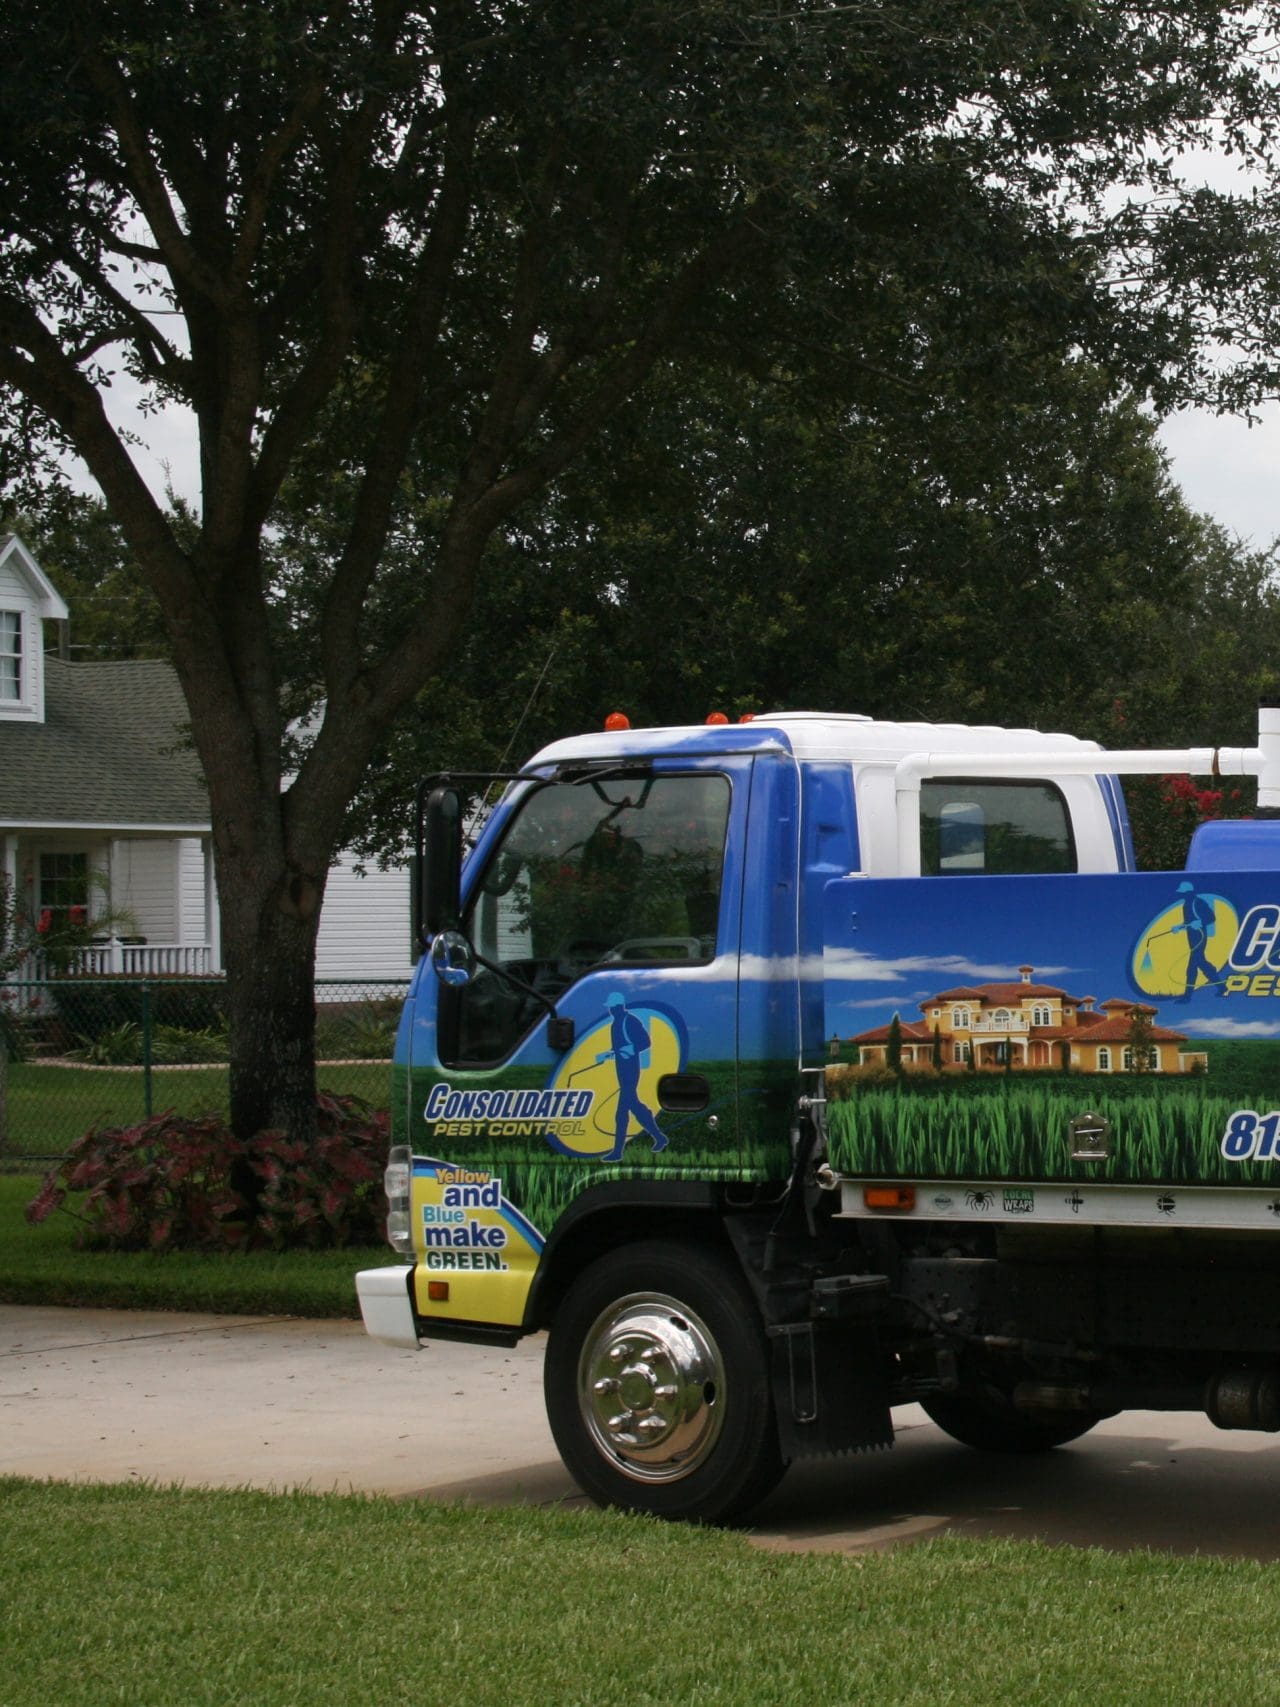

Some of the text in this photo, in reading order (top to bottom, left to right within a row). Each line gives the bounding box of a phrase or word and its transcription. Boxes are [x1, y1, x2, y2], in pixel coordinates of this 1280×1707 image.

[424, 1083, 594, 1121] CONSOLIDATED
[434, 1122, 587, 1136] PEST CONTROL
[435, 1168, 491, 1185] Yellow
[444, 1178, 502, 1209] and
[423, 1206, 465, 1224] Blue
[1003, 1199, 1034, 1212] WRAPS
[424, 1222, 507, 1248] make
[427, 1250, 509, 1272] GREEN.
